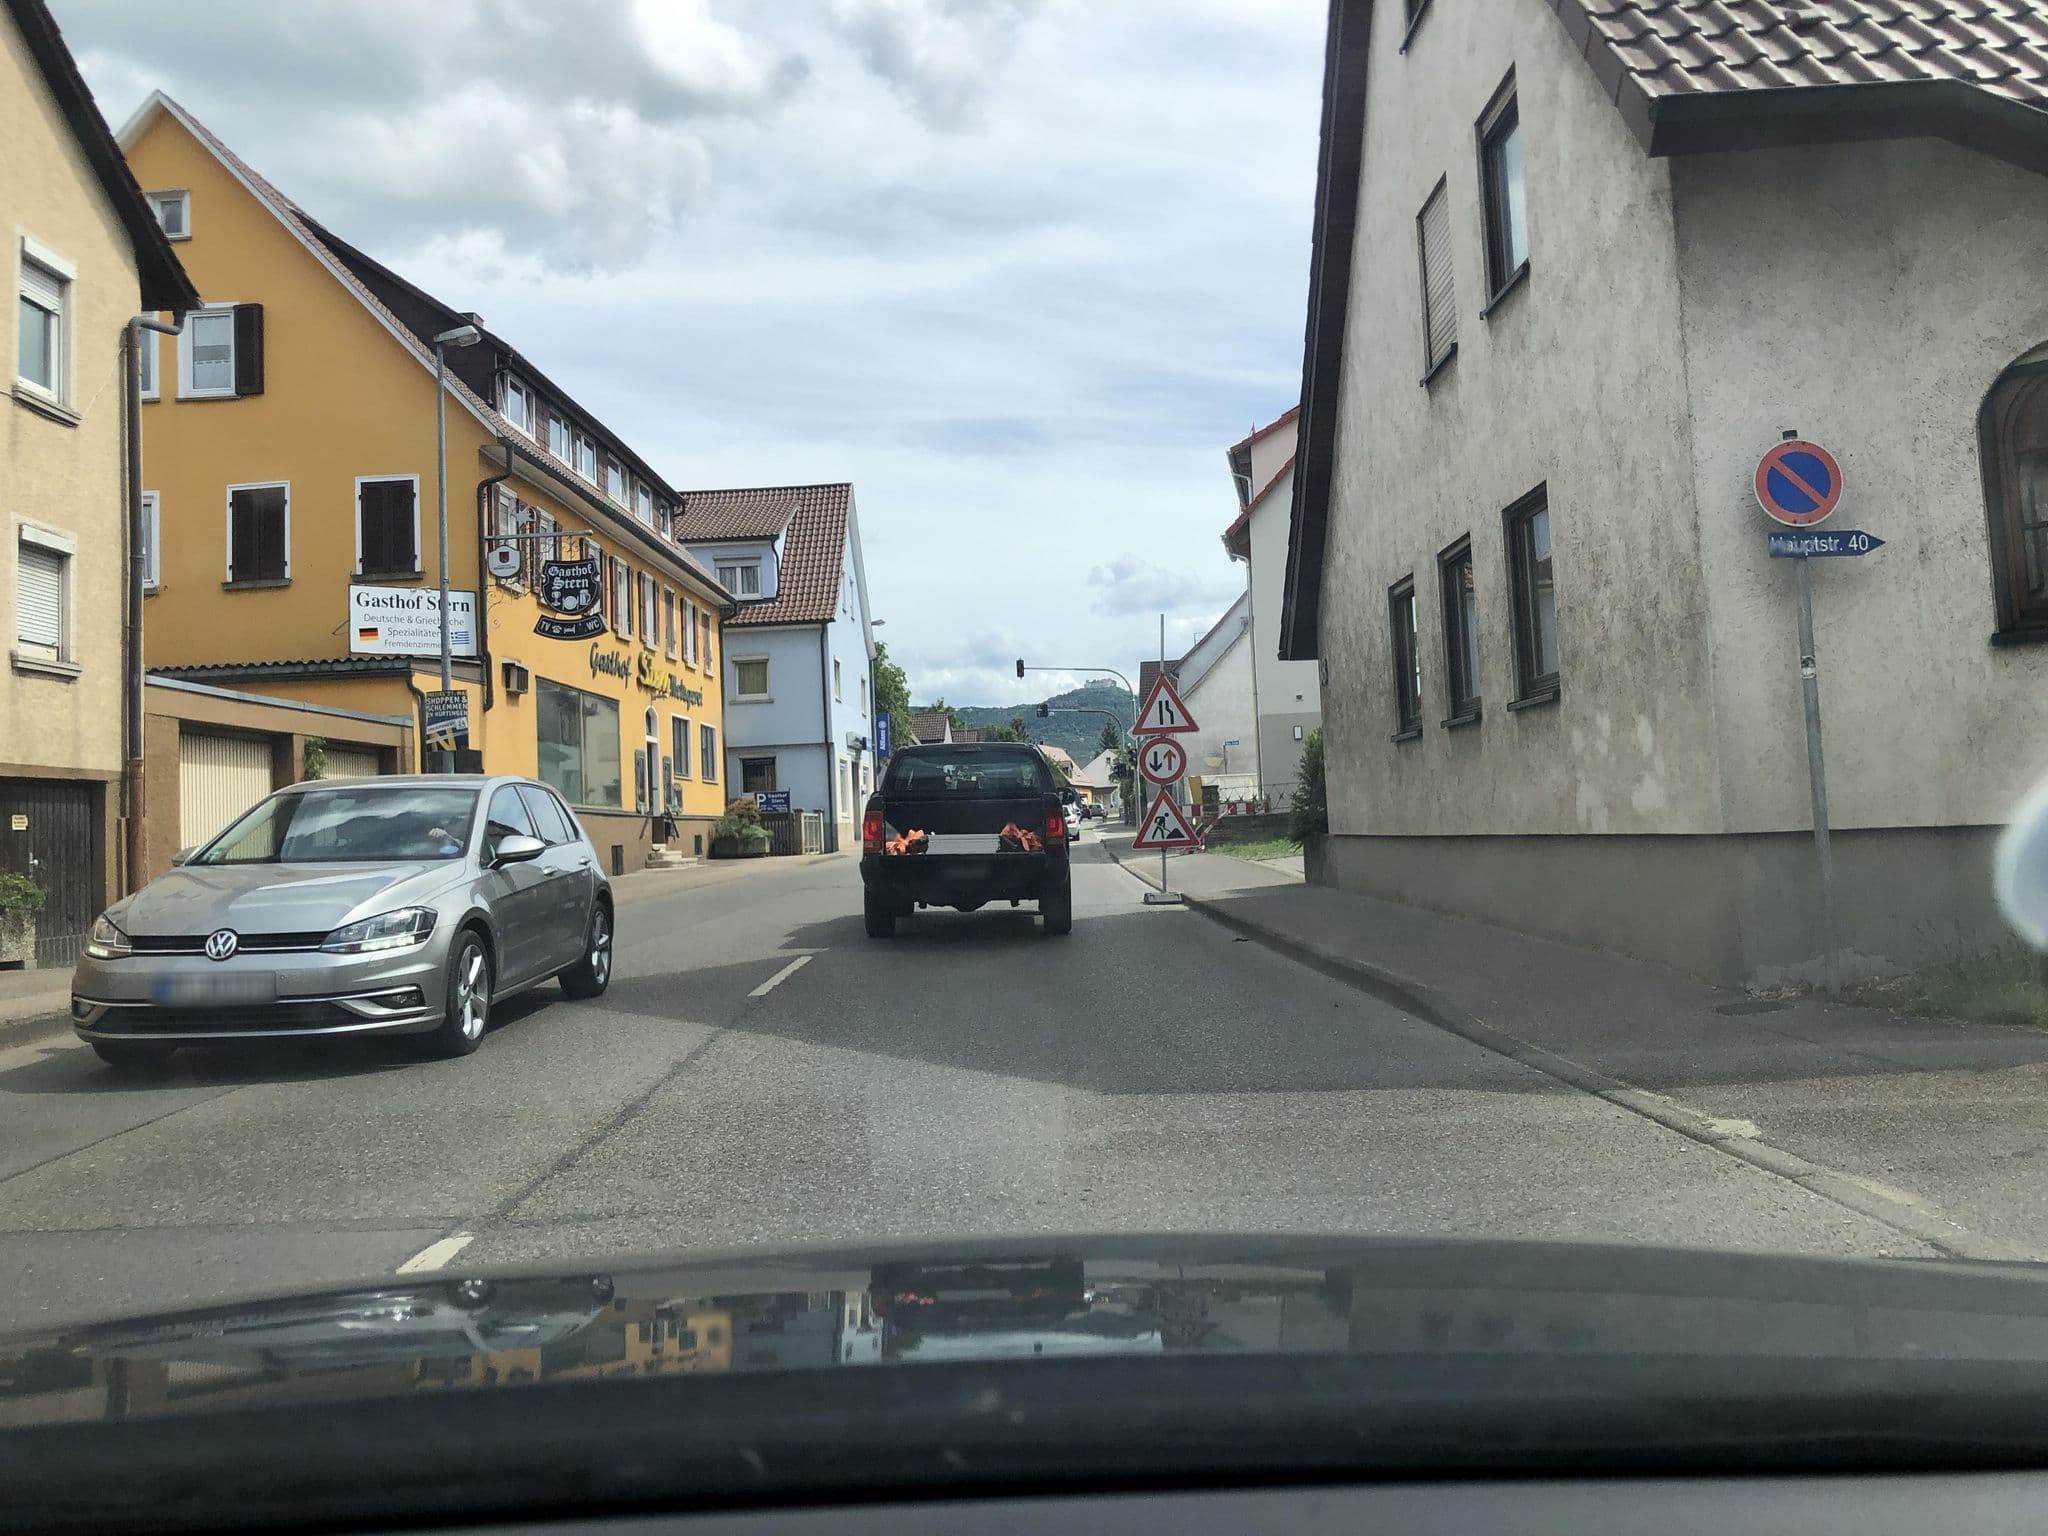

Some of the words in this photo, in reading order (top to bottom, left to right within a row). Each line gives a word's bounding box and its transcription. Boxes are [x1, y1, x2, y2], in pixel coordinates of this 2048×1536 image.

[1848, 534, 1869, 551] 40
[547, 563, 592, 578] Gasthof
[552, 577, 589, 591] Stern
[356, 591, 423, 610] Gasthof
[363, 613, 405, 624] Deutsche
[407, 615, 413, 624] &
[415, 616, 464, 626] Griechche
[541, 621, 552, 632] TV
[586, 620, 600, 630] WC
[384, 639, 441, 649] Fremdenzimme
[590, 642, 632, 690] Gasthof
[756, 793, 767, 809] P
